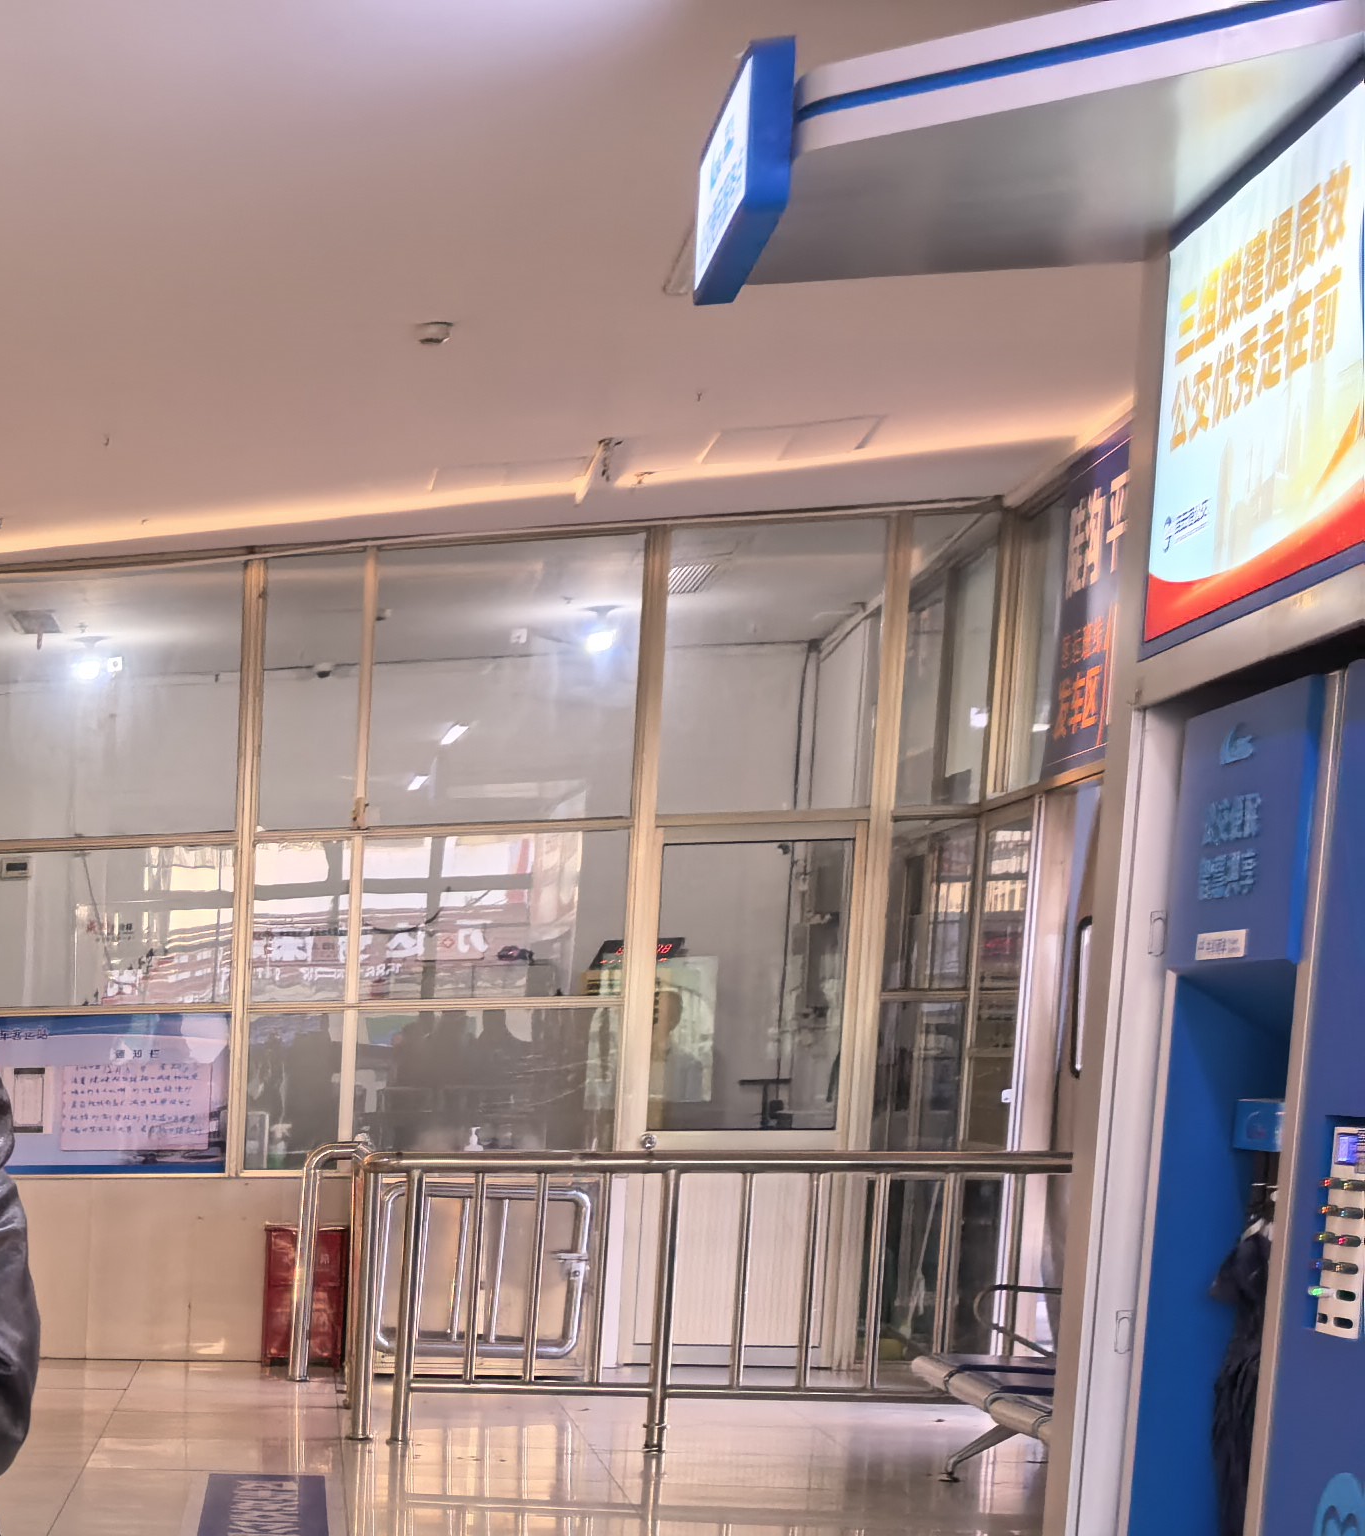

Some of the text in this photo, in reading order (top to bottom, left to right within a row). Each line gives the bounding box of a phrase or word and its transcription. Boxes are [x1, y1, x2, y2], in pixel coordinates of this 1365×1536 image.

[1170, 265, 1342, 452] 公交优秀走在前
